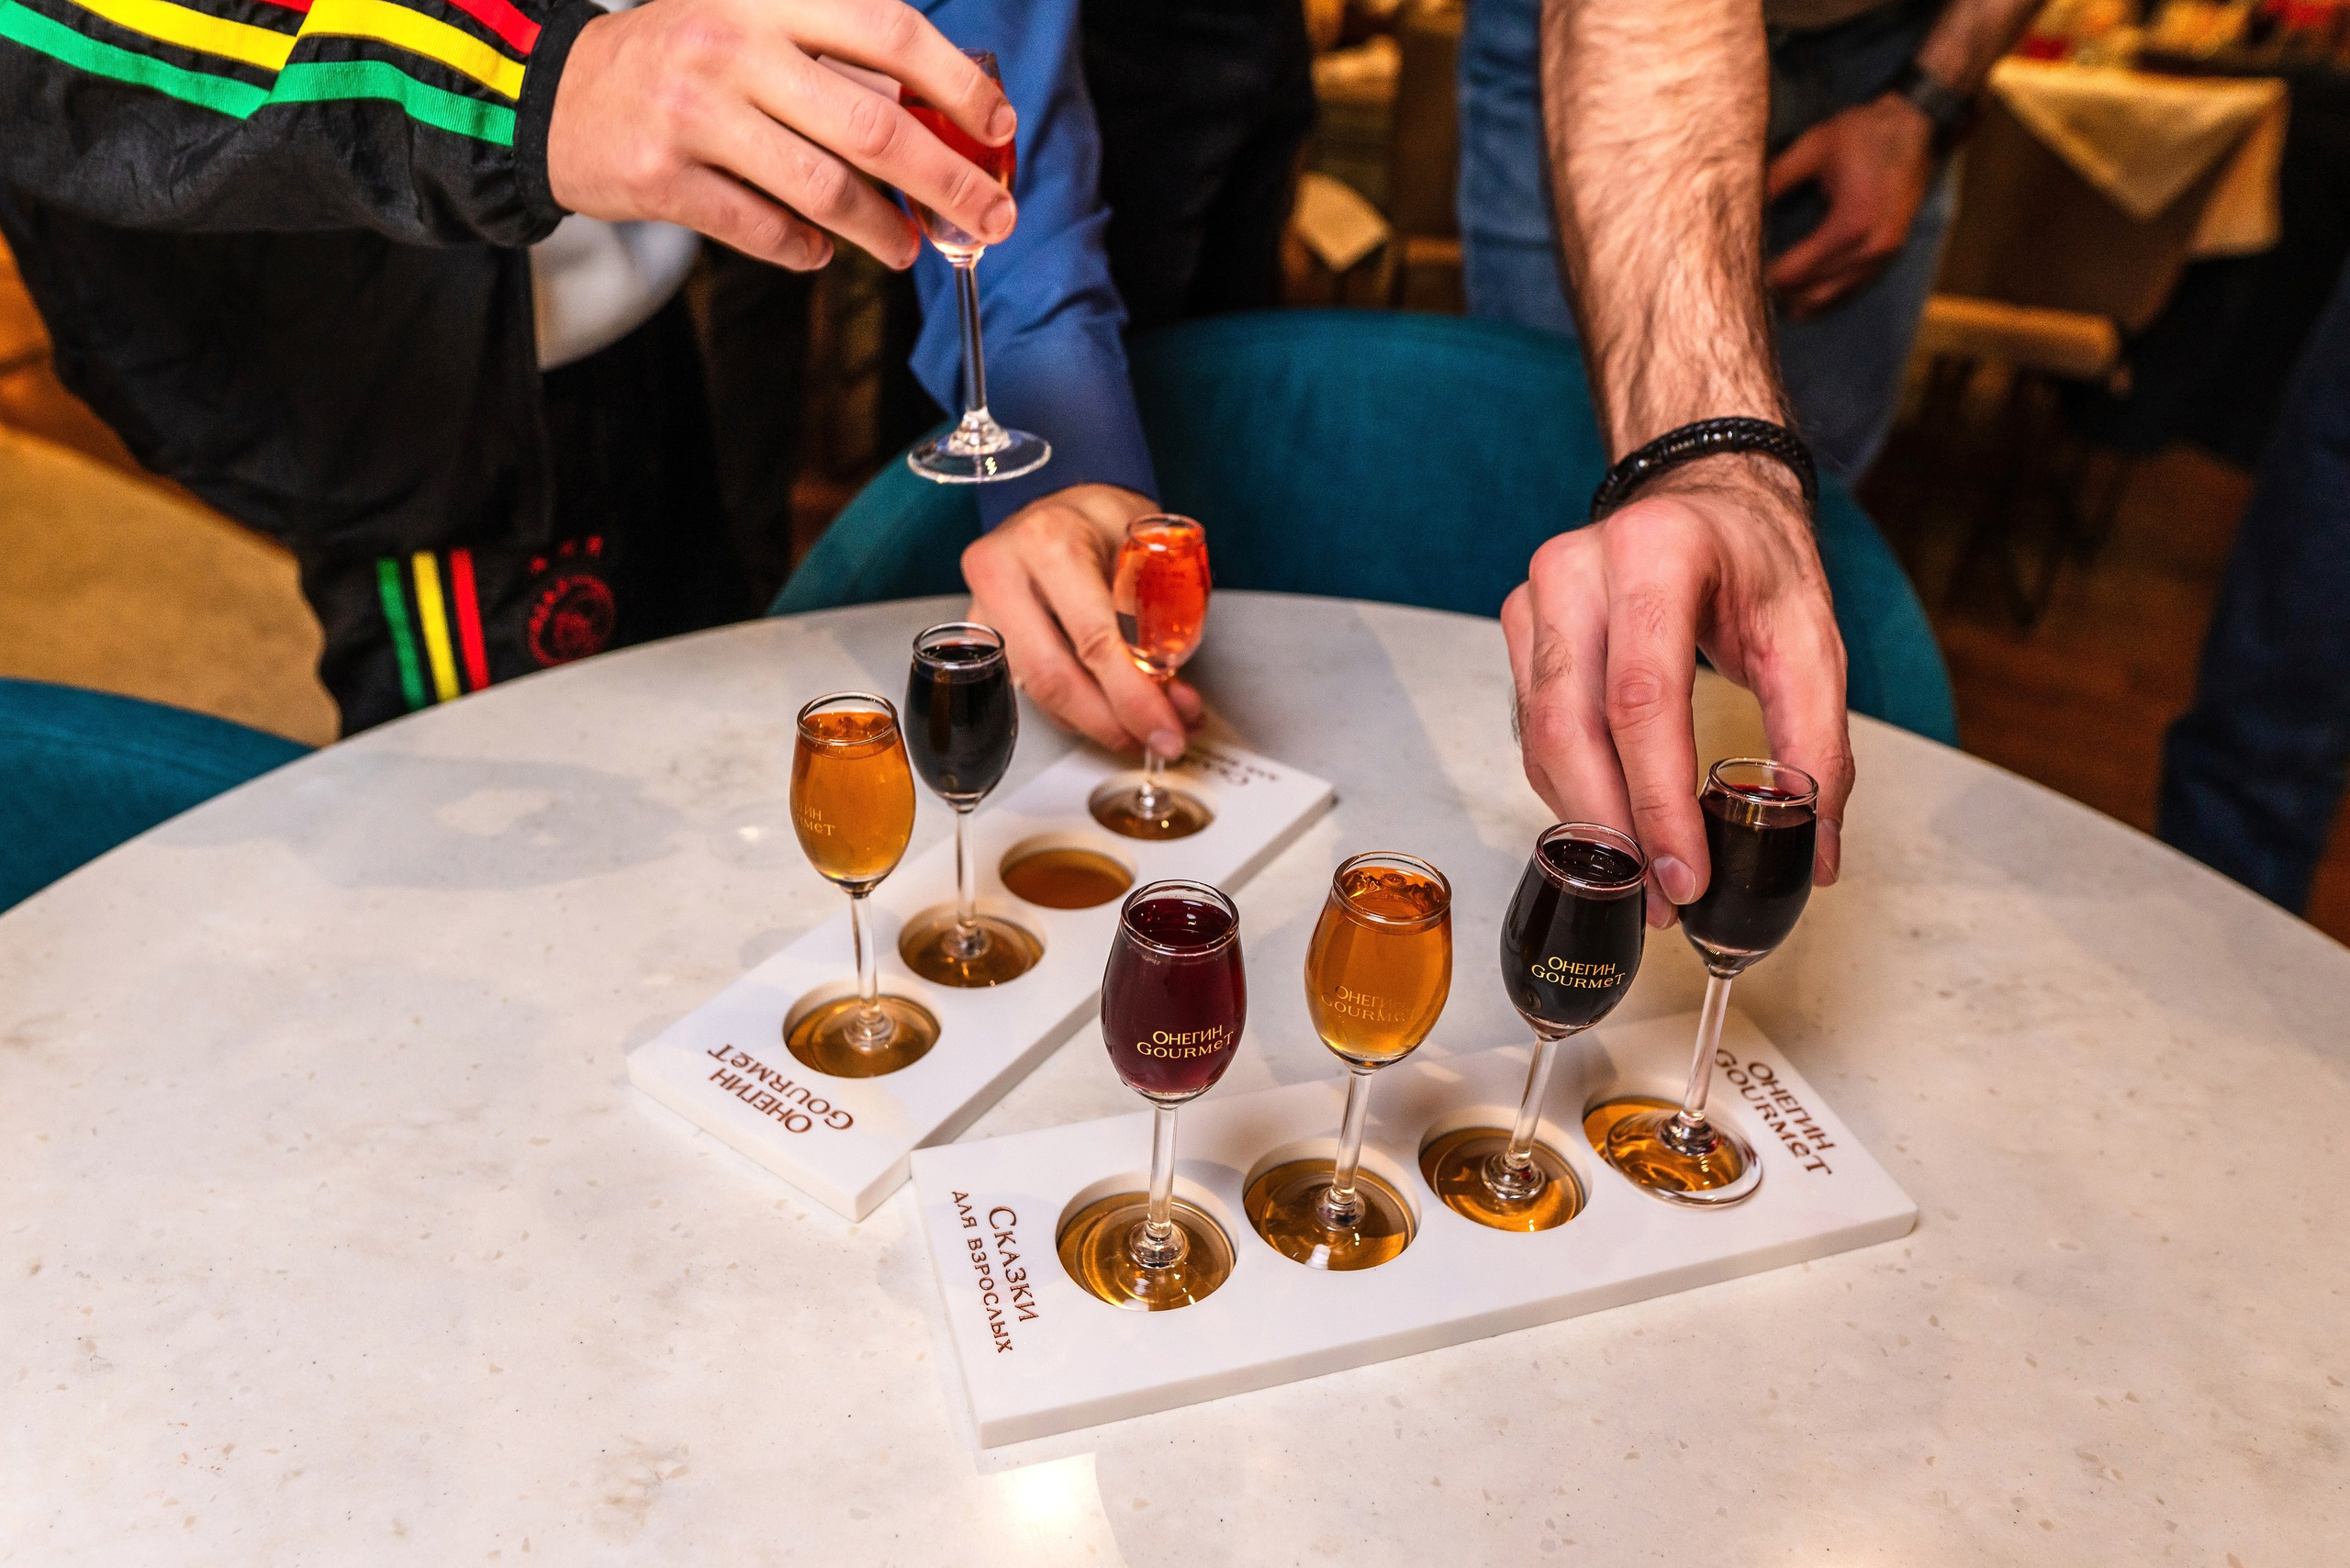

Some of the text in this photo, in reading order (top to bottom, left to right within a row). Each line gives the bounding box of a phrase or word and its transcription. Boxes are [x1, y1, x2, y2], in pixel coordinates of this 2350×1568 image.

[1548, 956, 1617, 977] ОНЕГИН
[1152, 1025, 1224, 1046] ОНЕГИН
[708, 1067, 813, 1134] ОНЕГИН
[1747, 1061, 1836, 1151] ОНЕГИН
[951, 1190, 1013, 1354] ДЛЯ ВЗРОСЛЫХ
[989, 1205, 1040, 1323] СКАЗКИ
